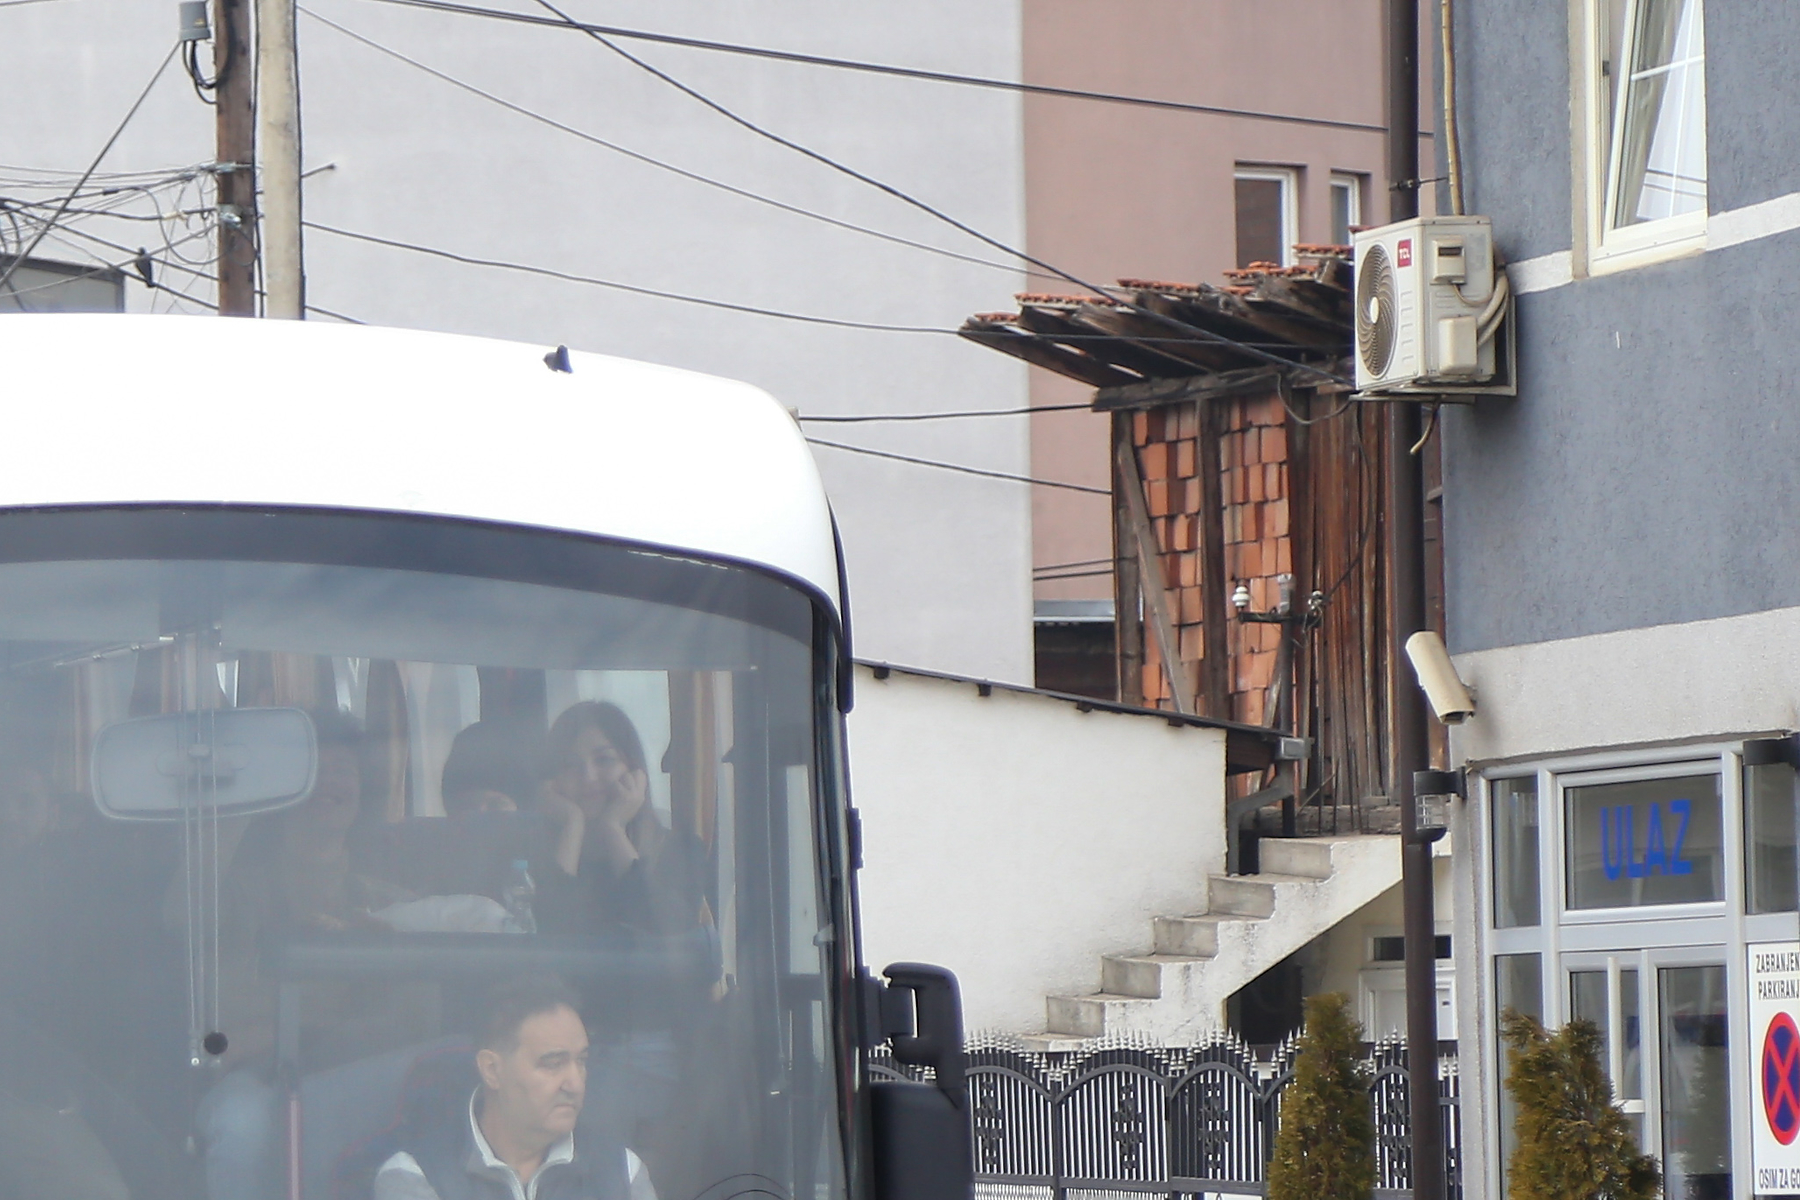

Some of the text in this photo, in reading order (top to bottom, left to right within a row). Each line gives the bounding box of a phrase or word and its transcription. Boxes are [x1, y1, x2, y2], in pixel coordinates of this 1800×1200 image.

[1399, 248, 1410, 259] TCL
[1600, 799, 1693, 881] ULAZ
[1759, 1168, 1777, 1189] OSIM
[1780, 1168, 1789, 1189] ZA
